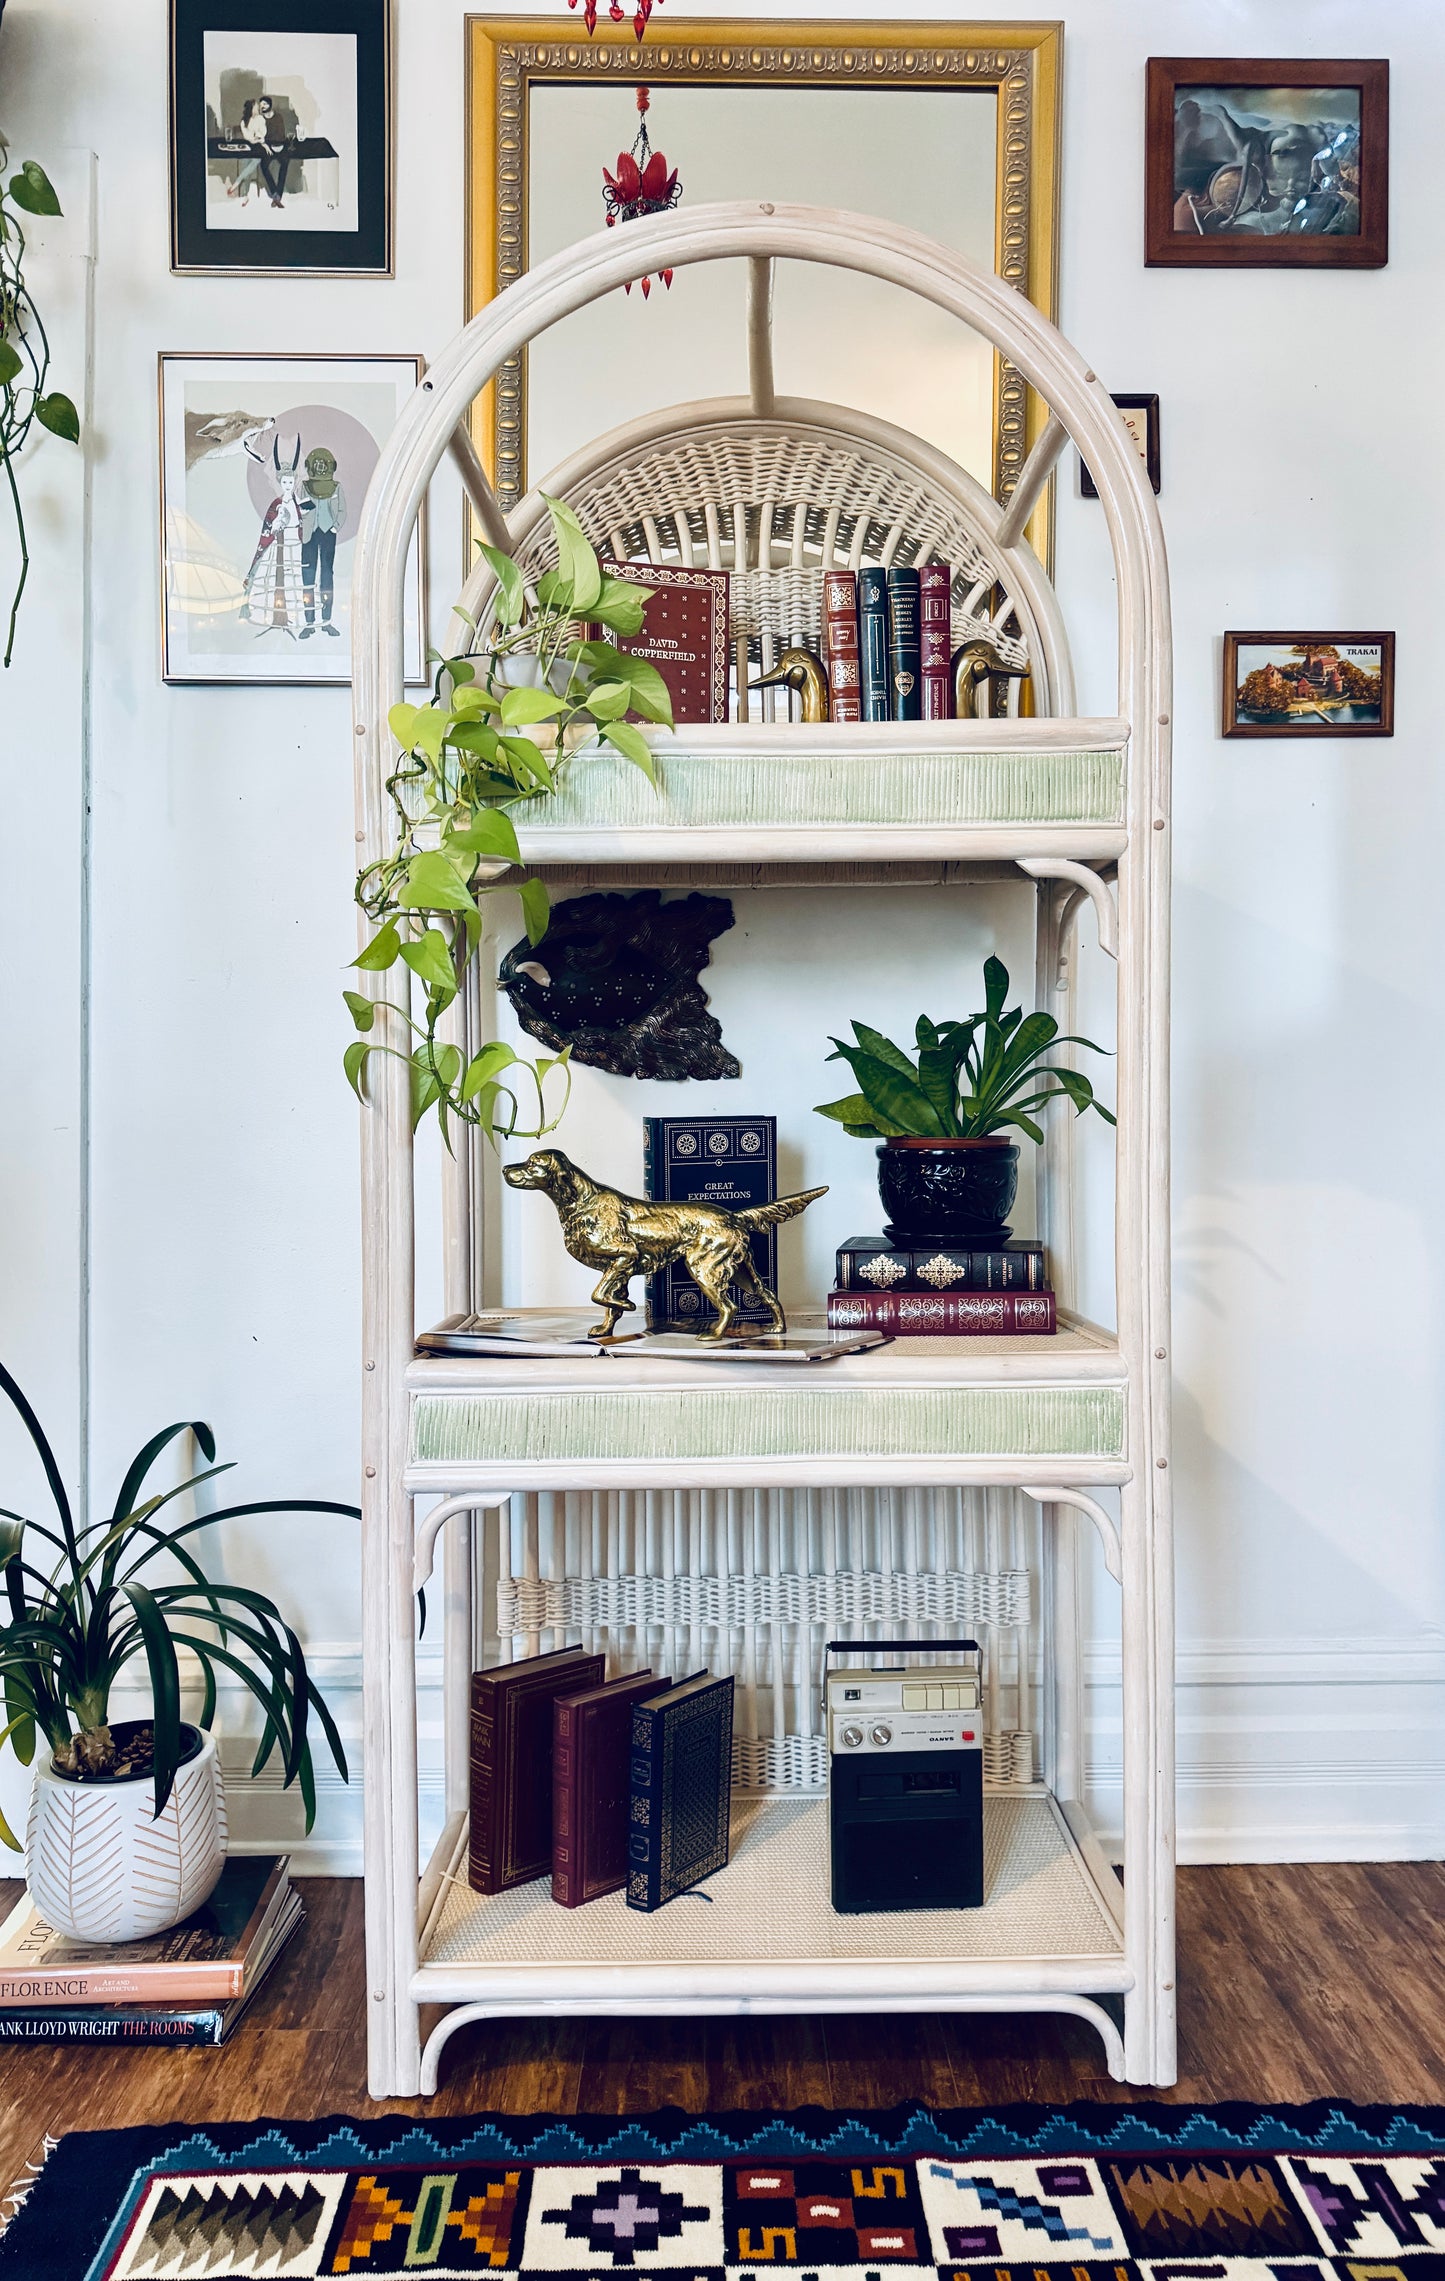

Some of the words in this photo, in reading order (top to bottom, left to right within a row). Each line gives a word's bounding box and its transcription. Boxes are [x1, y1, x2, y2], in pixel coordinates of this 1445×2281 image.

[649, 638, 678, 648] DAVID
[630, 648, 696, 662] COPPERFIELD
[704, 1182, 734, 1190] GREAT
[688, 1190, 751, 1201] EXPECTATIONS
[1, 1980, 88, 1997] FLORENCE
[25, 2021, 66, 2036] LLOYD
[68, 2020, 120, 2036] WRIGHT
[121, 2021, 148, 2036] THE
[150, 2020, 195, 2036] ROOMS
